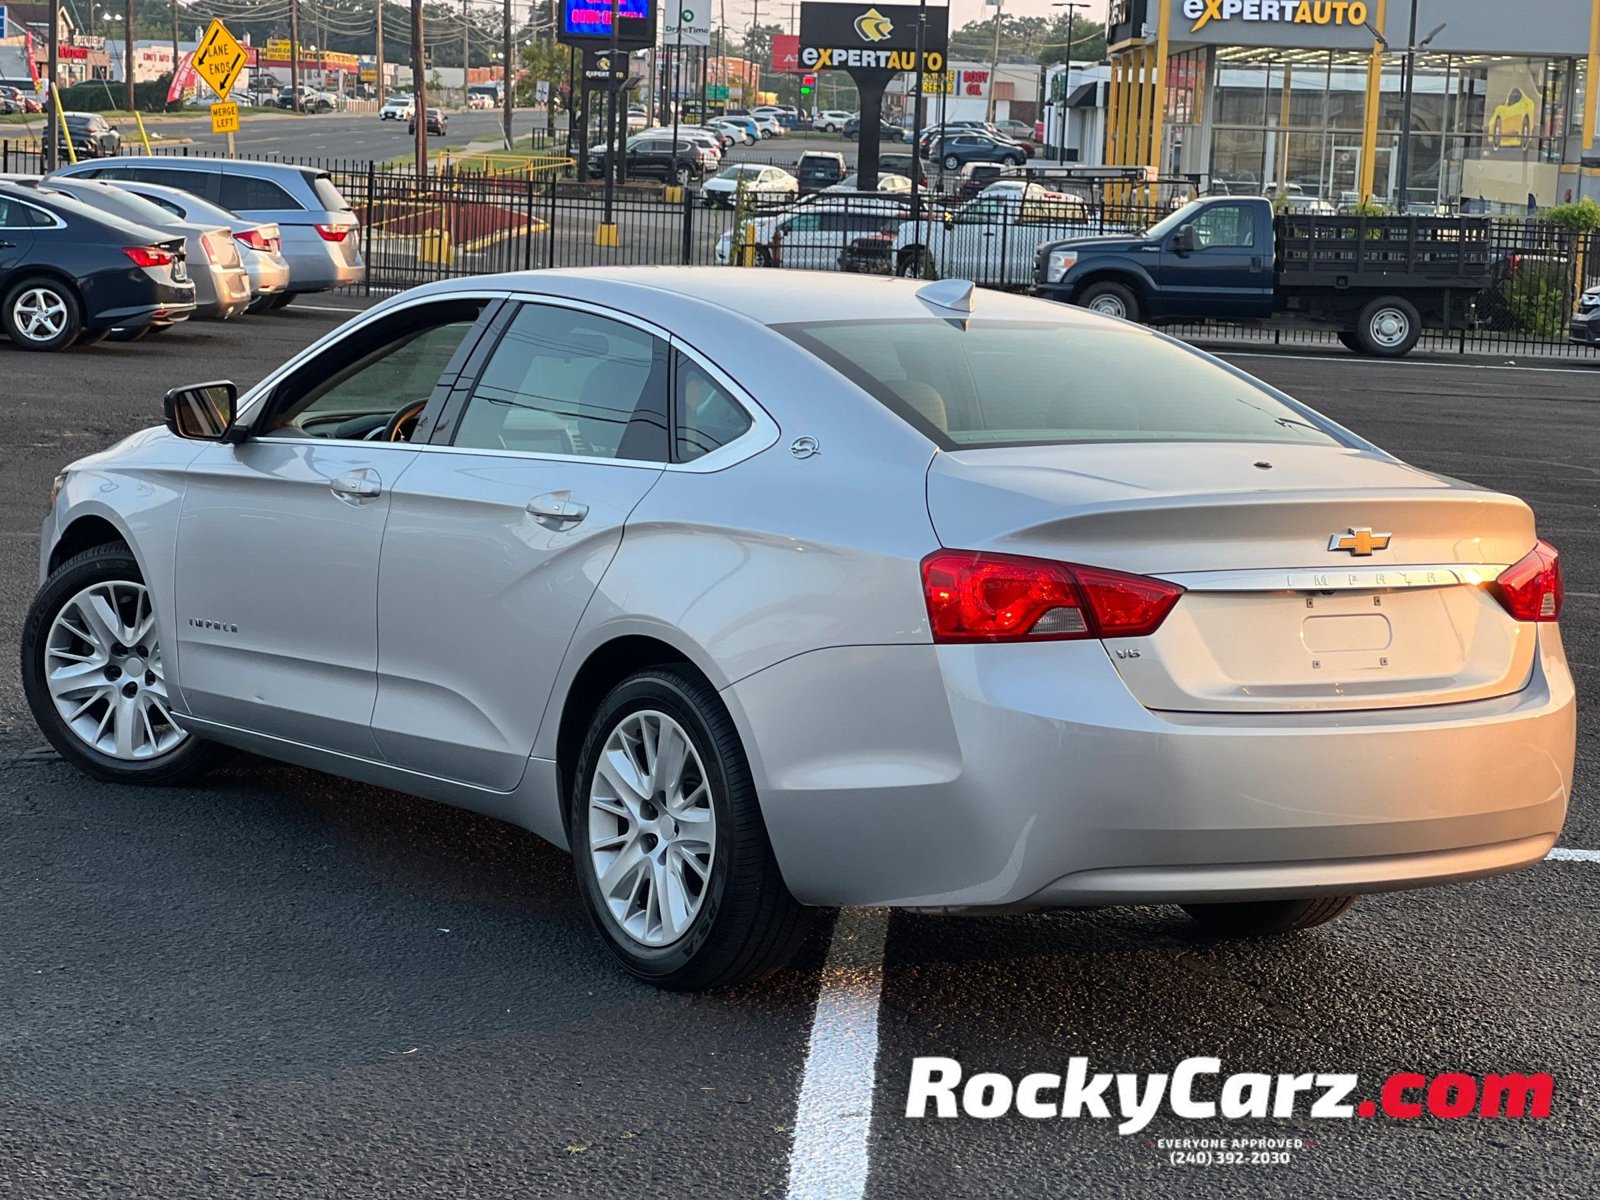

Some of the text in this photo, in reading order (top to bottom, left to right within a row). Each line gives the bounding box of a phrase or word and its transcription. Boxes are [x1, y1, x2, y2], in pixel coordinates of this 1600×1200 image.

[665, 25, 709, 34] DreTime
[207, 44, 229, 57] LANE
[209, 62, 231, 75] ENDS
[963, 70, 989, 83] BODY
[966, 83, 982, 95] OIL
[212, 106, 236, 117] MERGE
[216, 118, 234, 128] LEFT
[188, 616, 238, 633] IMPALA
[1115, 649, 1141, 659] V6
